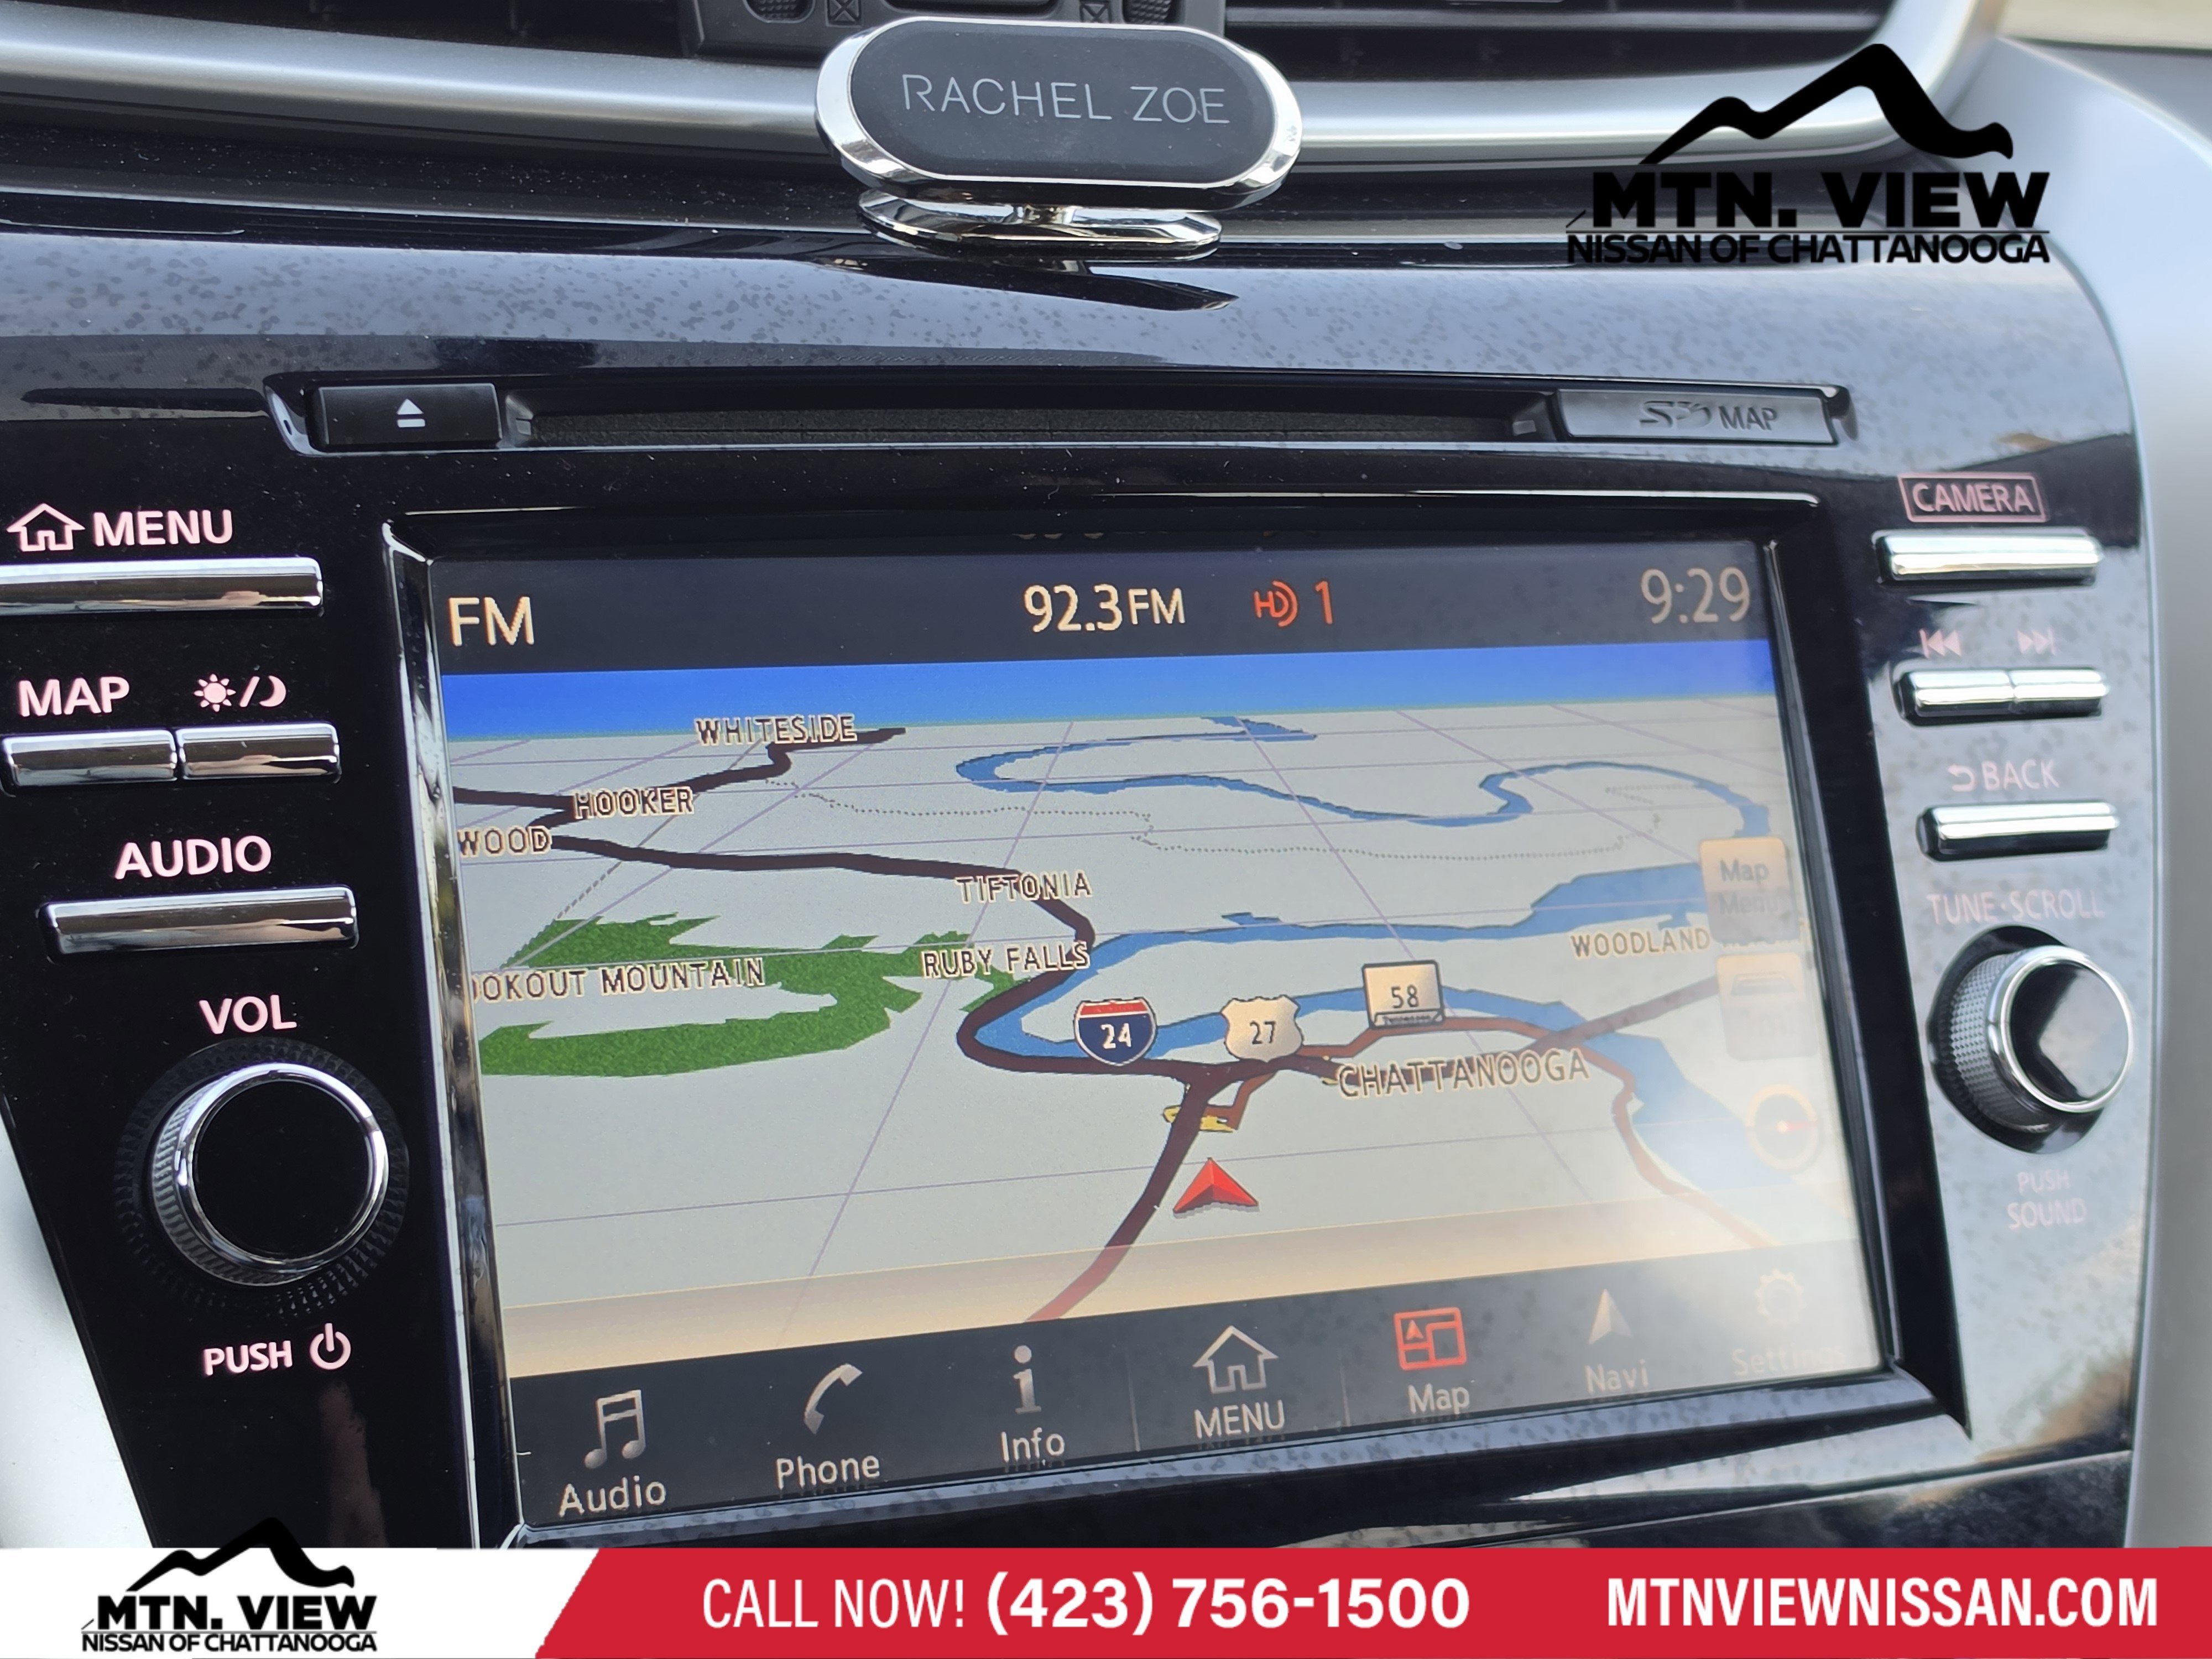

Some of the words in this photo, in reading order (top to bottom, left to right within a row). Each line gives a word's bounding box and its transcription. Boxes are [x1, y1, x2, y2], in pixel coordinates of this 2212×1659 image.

[902, 74, 1112, 120] RACHEL
[1131, 86, 1230, 124] ZOE
[1719, 405, 1778, 431] MAP
[1912, 483, 2035, 513] CAMERA
[92, 509, 233, 546] MENU
[1314, 581, 1333, 625] 1
[1640, 566, 1750, 624] 9:29
[447, 596, 535, 646] FM
[18, 676, 130, 717] MAP
[695, 713, 858, 746] WHITESIDE
[1981, 759, 2060, 791] BACK
[573, 786, 695, 819] HOOKER
[114, 836, 272, 880] AUDIO
[457, 826, 551, 857] WOOD
[955, 869, 1092, 904] TIFTONIA
[1719, 859, 1769, 884] Map
[921, 948, 993, 979] RUBY
[1006, 941, 1091, 973] FALLS
[1571, 927, 1710, 959] WOODLAND
[601, 958, 765, 995] MOUNTAIN
[199, 994, 297, 1035] VOL
[1391, 984, 1420, 1009] 58
[1100, 1022, 1133, 1049] 24
[1249, 1020, 1276, 1045] 27
[1338, 1047, 1592, 1098] CHATTANOOGA
[2017, 1168, 2070, 1194] PUSH
[2007, 1197, 2087, 1230] SOUND
[203, 1339, 293, 1376] PUSH
[1585, 1358, 1649, 1395] Navi
[1408, 1382, 1470, 1415] Map
[1194, 1399, 1286, 1439] MENU
[1000, 1427, 1066, 1463] Info
[776, 1453, 881, 1490] Phone
[559, 1475, 666, 1517] Audio
